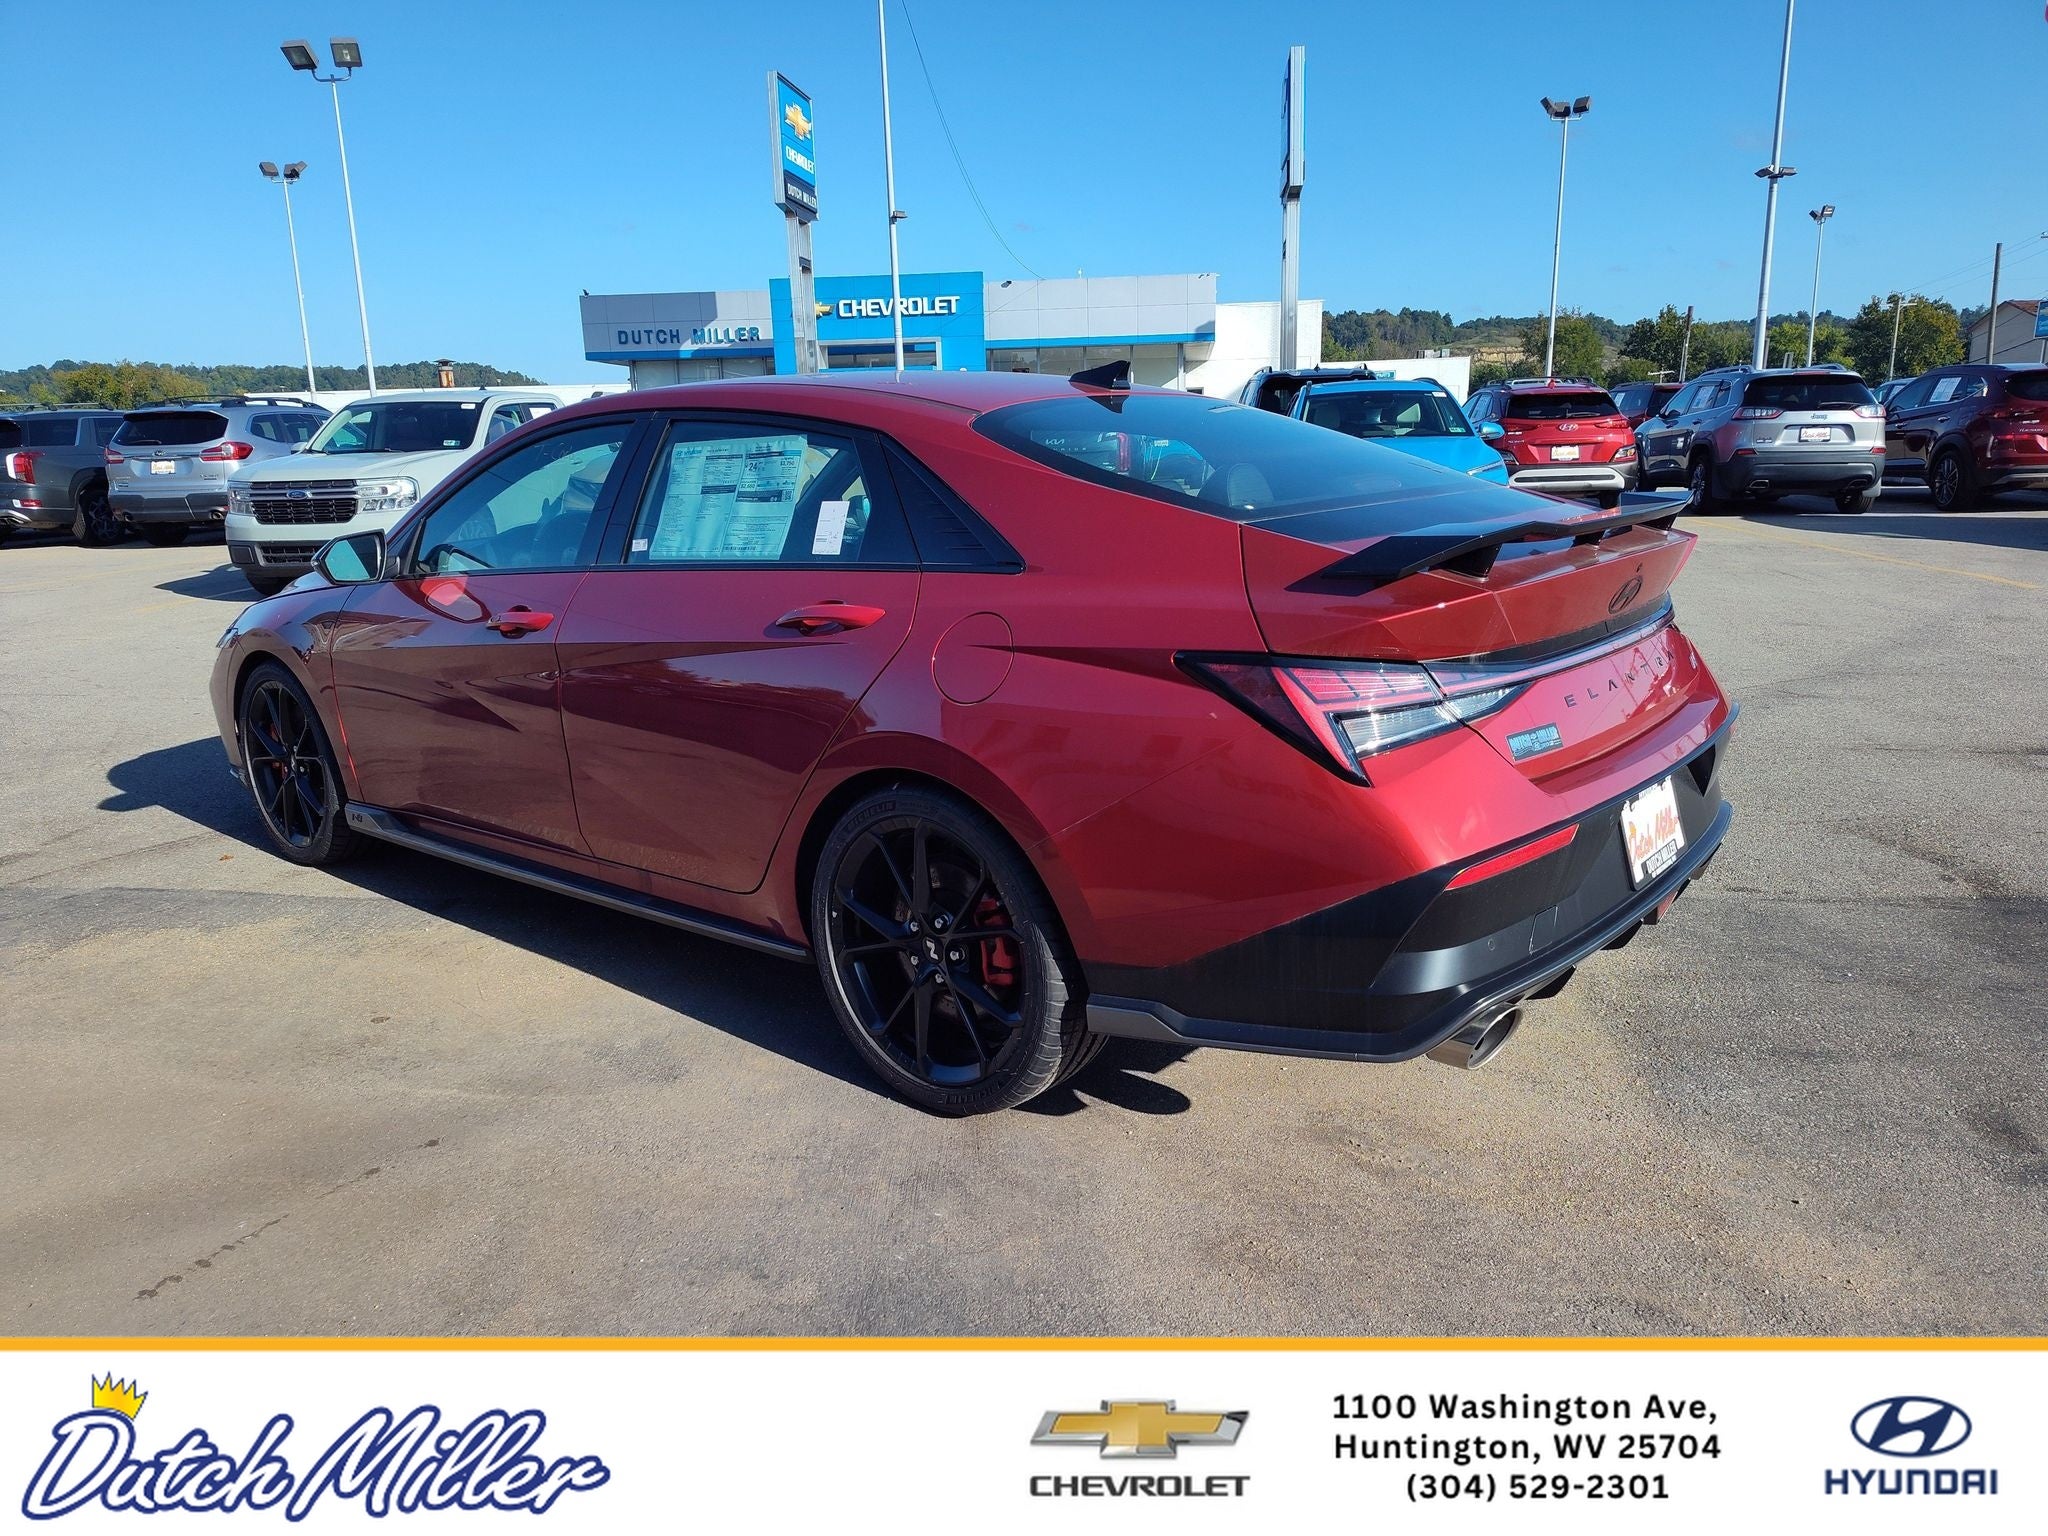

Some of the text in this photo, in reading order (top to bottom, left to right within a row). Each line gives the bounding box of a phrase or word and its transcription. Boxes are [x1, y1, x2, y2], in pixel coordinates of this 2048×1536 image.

[785, 145, 815, 175] CHEVROLET
[787, 183, 817, 209] DUTCH MILLER
[838, 295, 961, 318] CHEVROLET
[617, 325, 761, 346] DUTCH MILLER
[1564, 651, 1674, 708] ELANTRA
